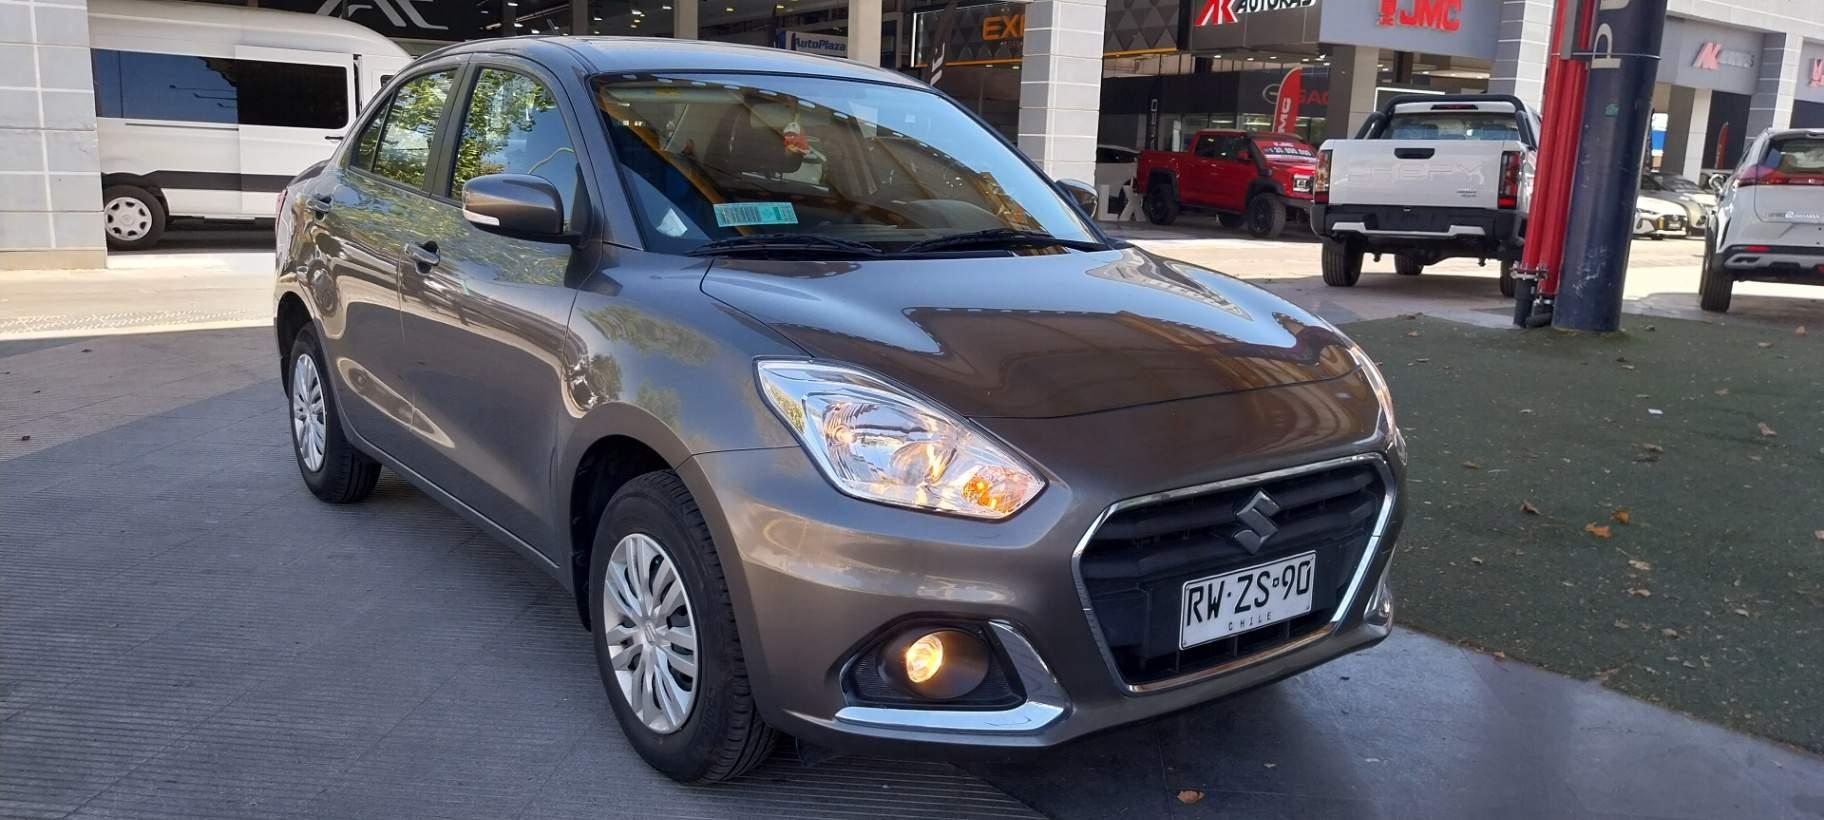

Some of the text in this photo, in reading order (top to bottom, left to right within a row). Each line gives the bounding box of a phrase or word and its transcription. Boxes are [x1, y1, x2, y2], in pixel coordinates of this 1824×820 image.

[1399, 0, 1462, 33] JMC
[796, 37, 846, 51] AutoPlaza
[1228, 611, 1271, 632] CHILE
